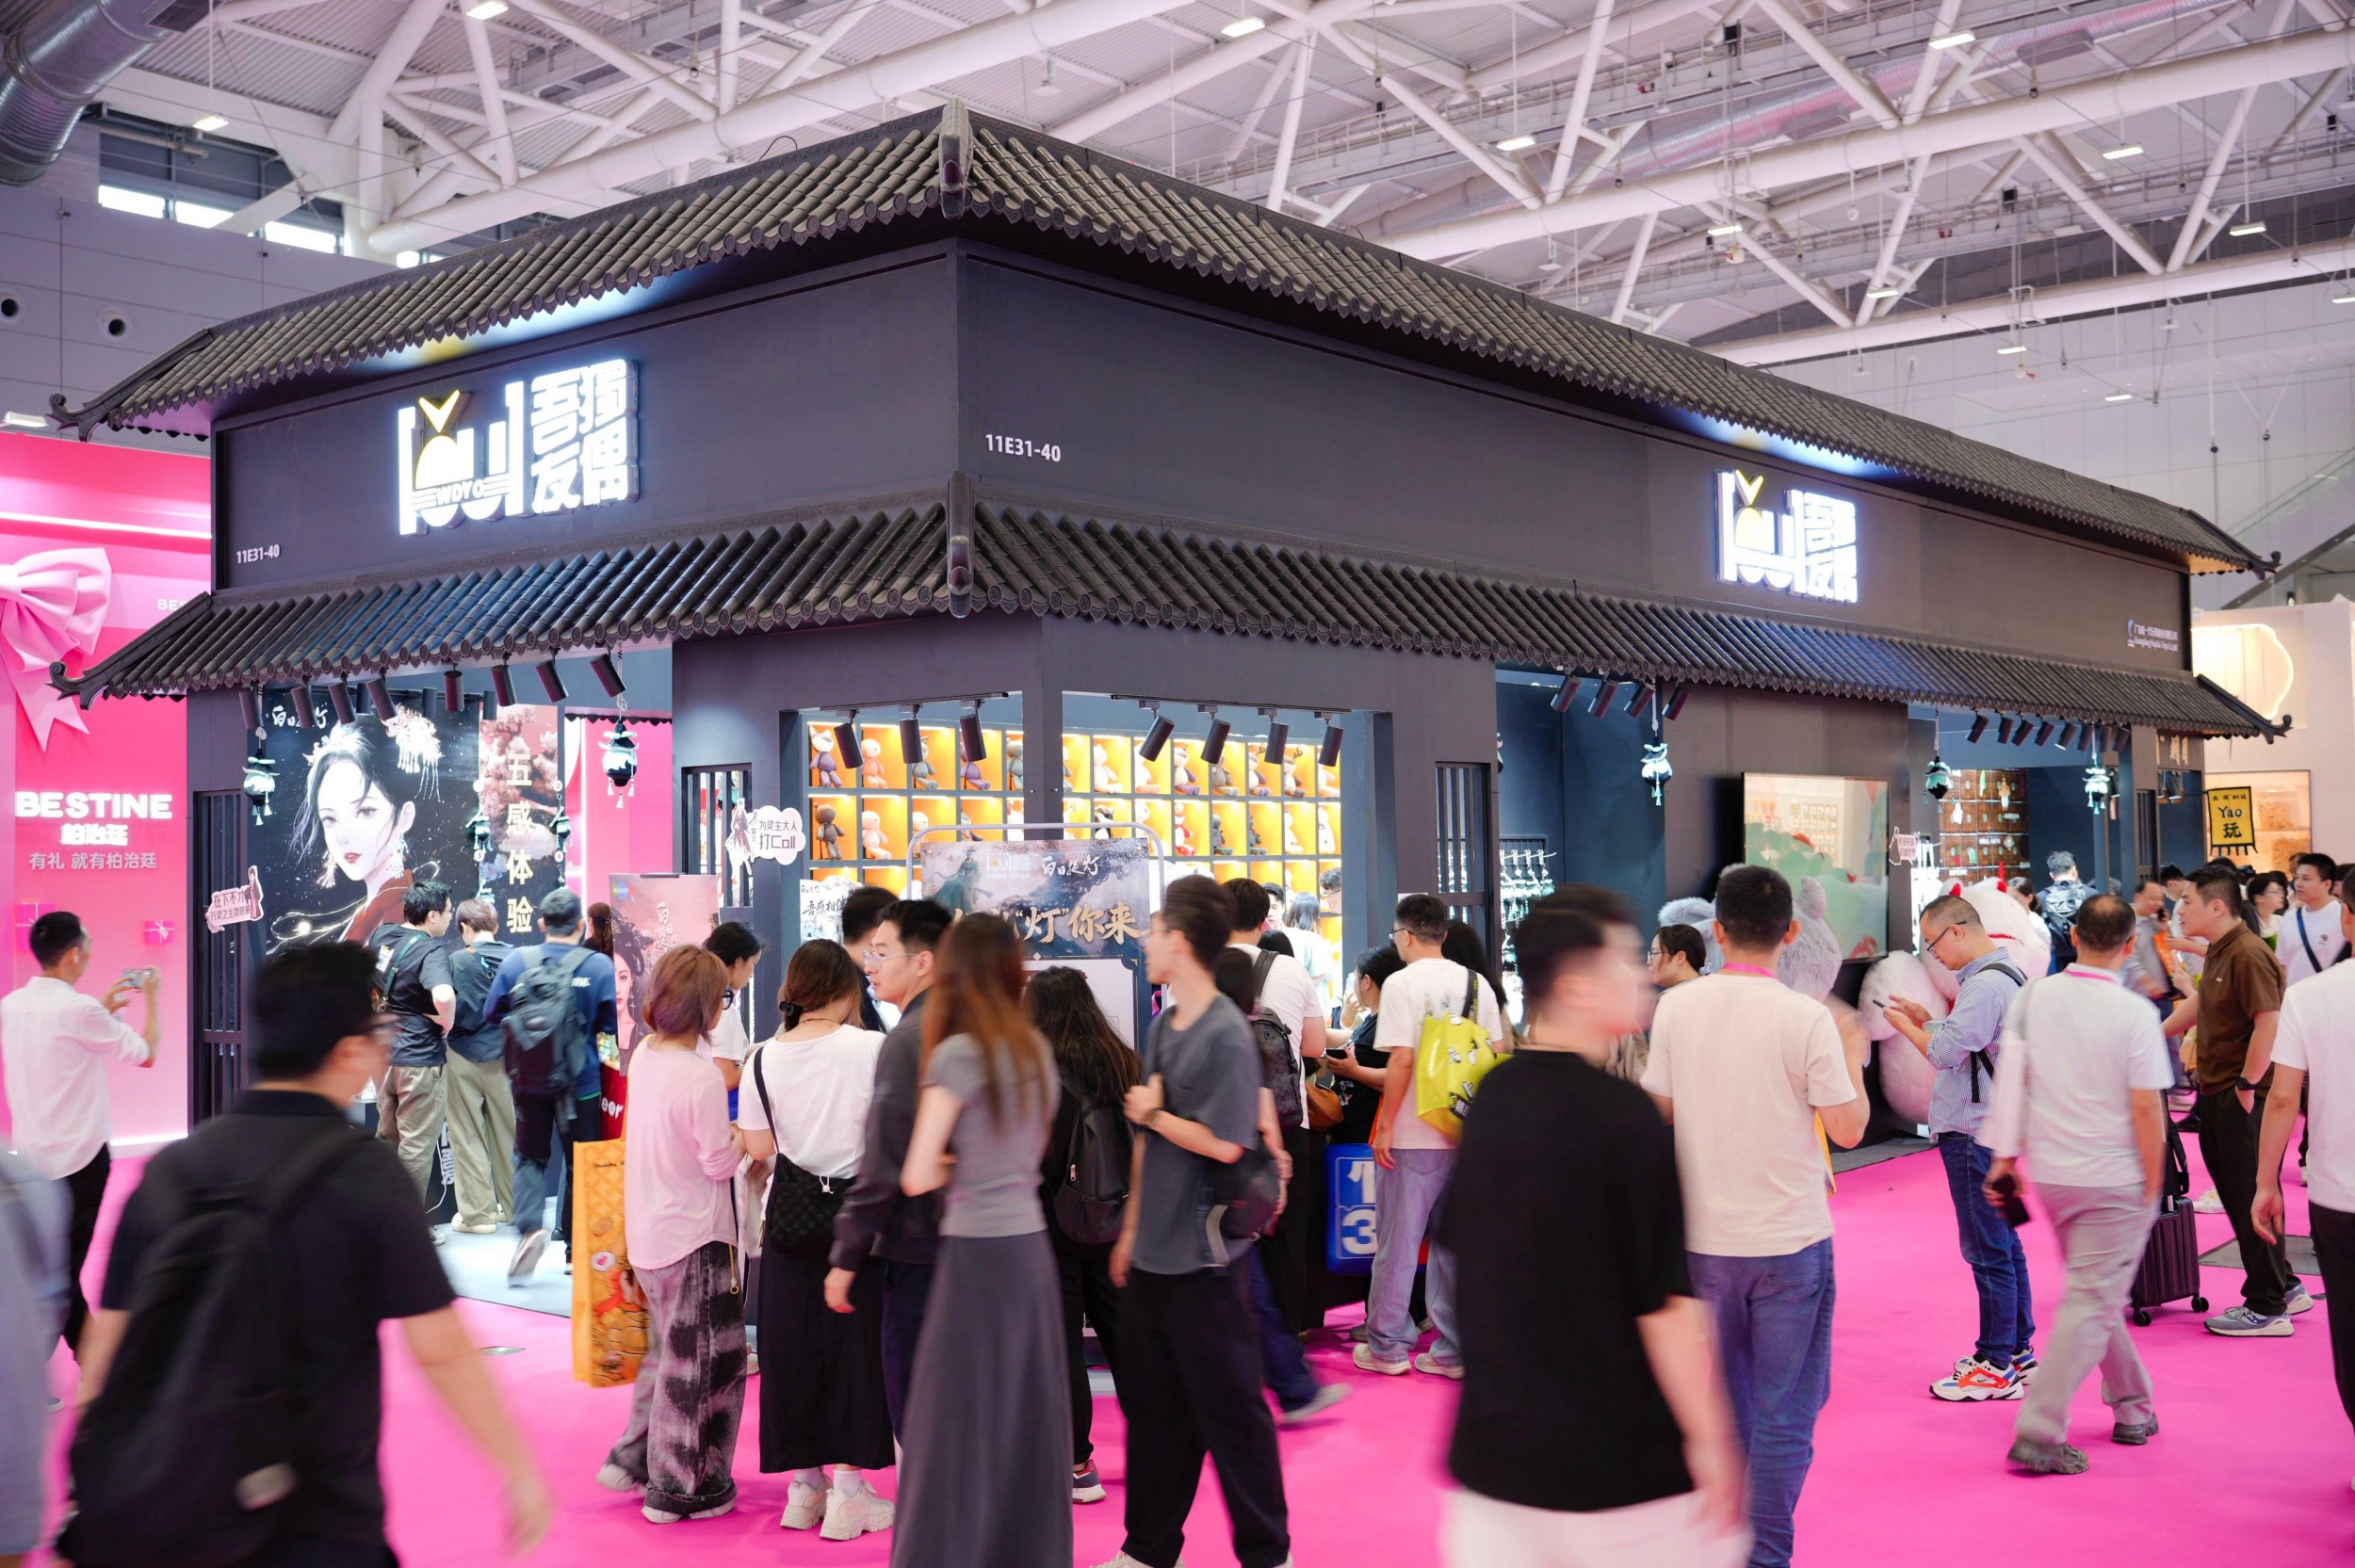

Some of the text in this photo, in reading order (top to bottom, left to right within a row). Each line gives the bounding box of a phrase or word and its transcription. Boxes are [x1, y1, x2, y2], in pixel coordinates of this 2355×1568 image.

[985, 434, 1061, 462] 11E31-40
[436, 479, 484, 506] WDYO
[236, 544, 281, 564] 11E31-40
[15, 791, 173, 819] BESTINE
[2217, 806, 2243, 818] Yao
[759, 819, 798, 832] 为灵主大人
[2223, 821, 2242, 839] 玩
[506, 753, 534, 934] 五感体验
[759, 833, 796, 850] 打Call
[29, 852, 157, 870] 有礼 就有柏治廷
[952, 900, 1142, 946] “灯”你来
